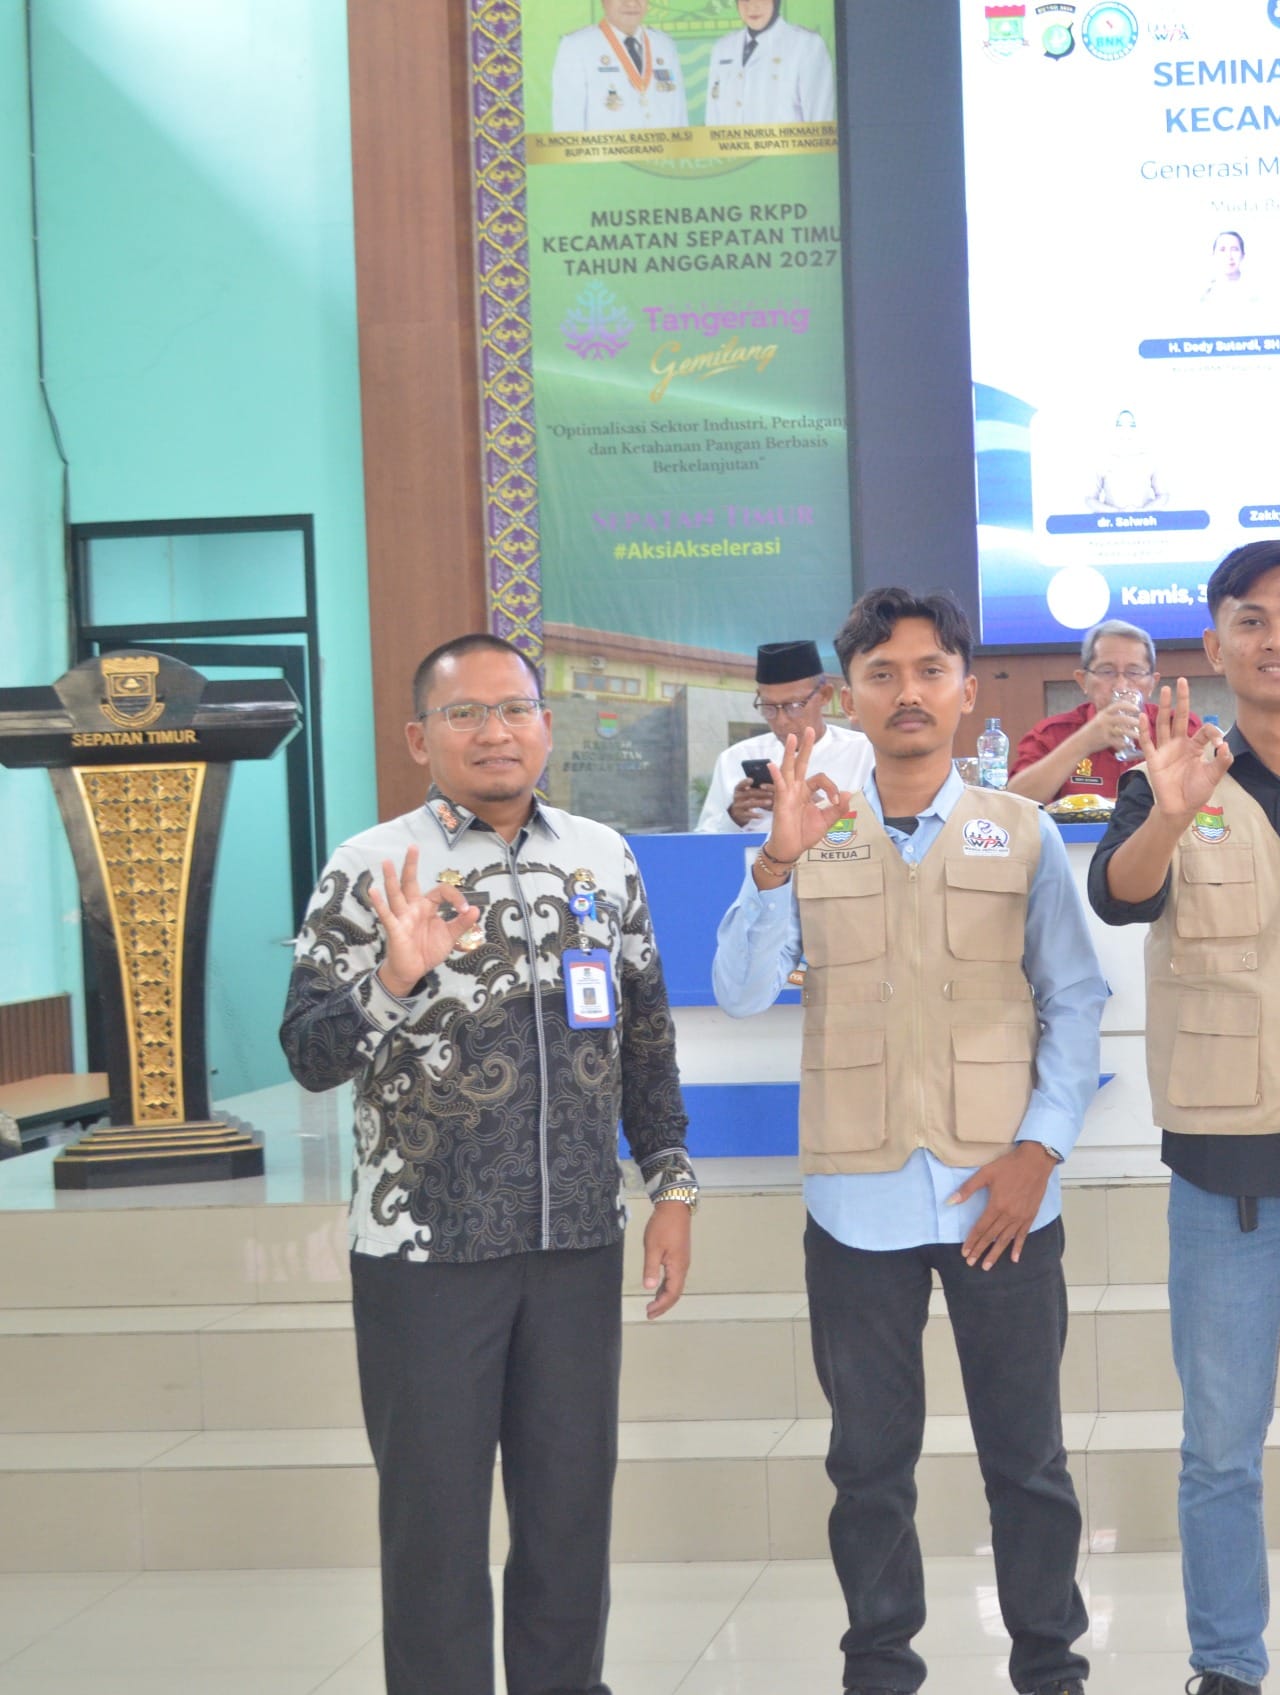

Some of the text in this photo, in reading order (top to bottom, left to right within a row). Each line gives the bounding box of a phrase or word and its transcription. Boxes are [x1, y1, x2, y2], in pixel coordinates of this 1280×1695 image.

[710, 129, 741, 140] INTAN
[743, 127, 776, 139] NURUL
[754, 139, 789, 150] BUPATI
[791, 137, 838, 149] TANGERA
[565, 144, 664, 157] BUPATI TANGERANG
[1140, 155, 1249, 180] Generasi
[590, 203, 808, 228] MUSRENBANG RKPD
[543, 226, 841, 254] KECAMATAN SEPATAN TIMU
[564, 249, 837, 277] TAHUN ANGGARAN 2027
[642, 306, 812, 338] Tangerang
[650, 335, 779, 403] Gemilang
[650, 418, 699, 434] Sektor
[588, 435, 829, 456] dan Ketahanan Pangan Berbasis
[612, 537, 782, 561] #AksiAkselerasi
[1121, 583, 1194, 607] Kamis,
[72, 730, 197, 747] SEPATAN TIMUR
[970, 838, 1004, 848] WPA
[820, 850, 858, 860] KETUA
